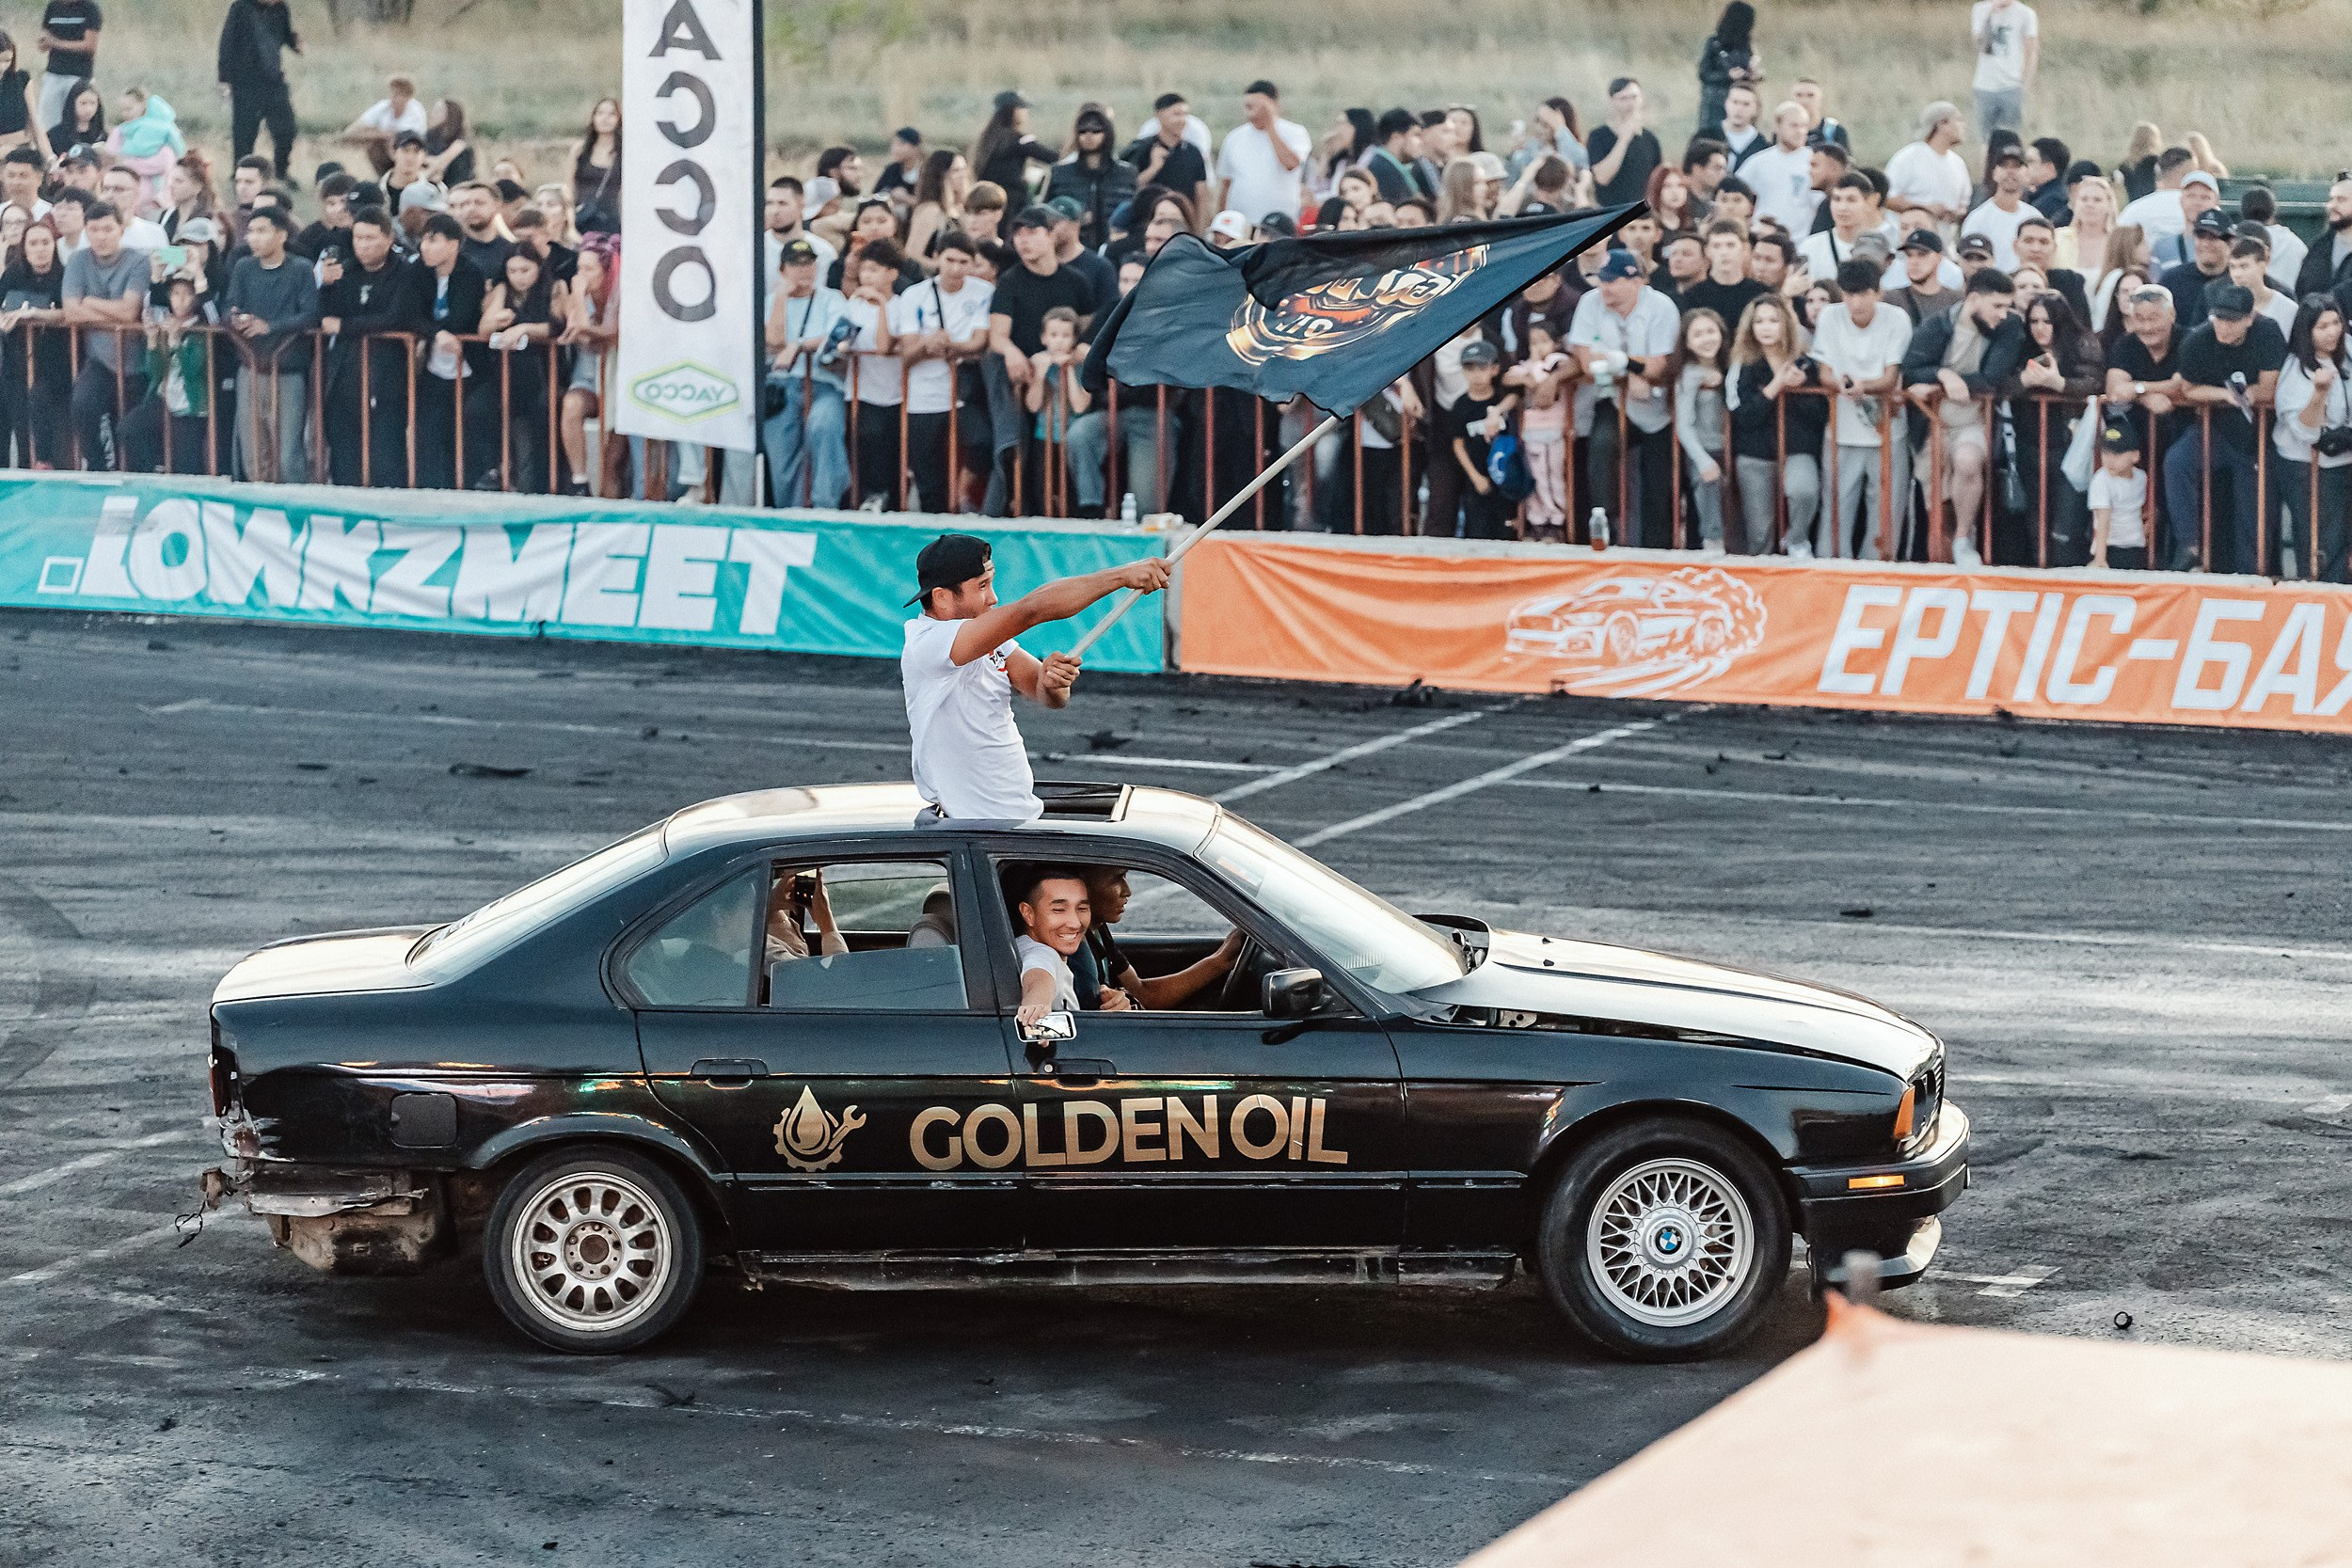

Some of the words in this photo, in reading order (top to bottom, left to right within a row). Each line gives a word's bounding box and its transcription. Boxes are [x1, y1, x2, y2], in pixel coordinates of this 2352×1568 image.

[79, 495, 817, 635] LOWKZMEET
[909, 1096, 1219, 1171] GOLDEN
[1231, 1093, 1348, 1164] OIL
